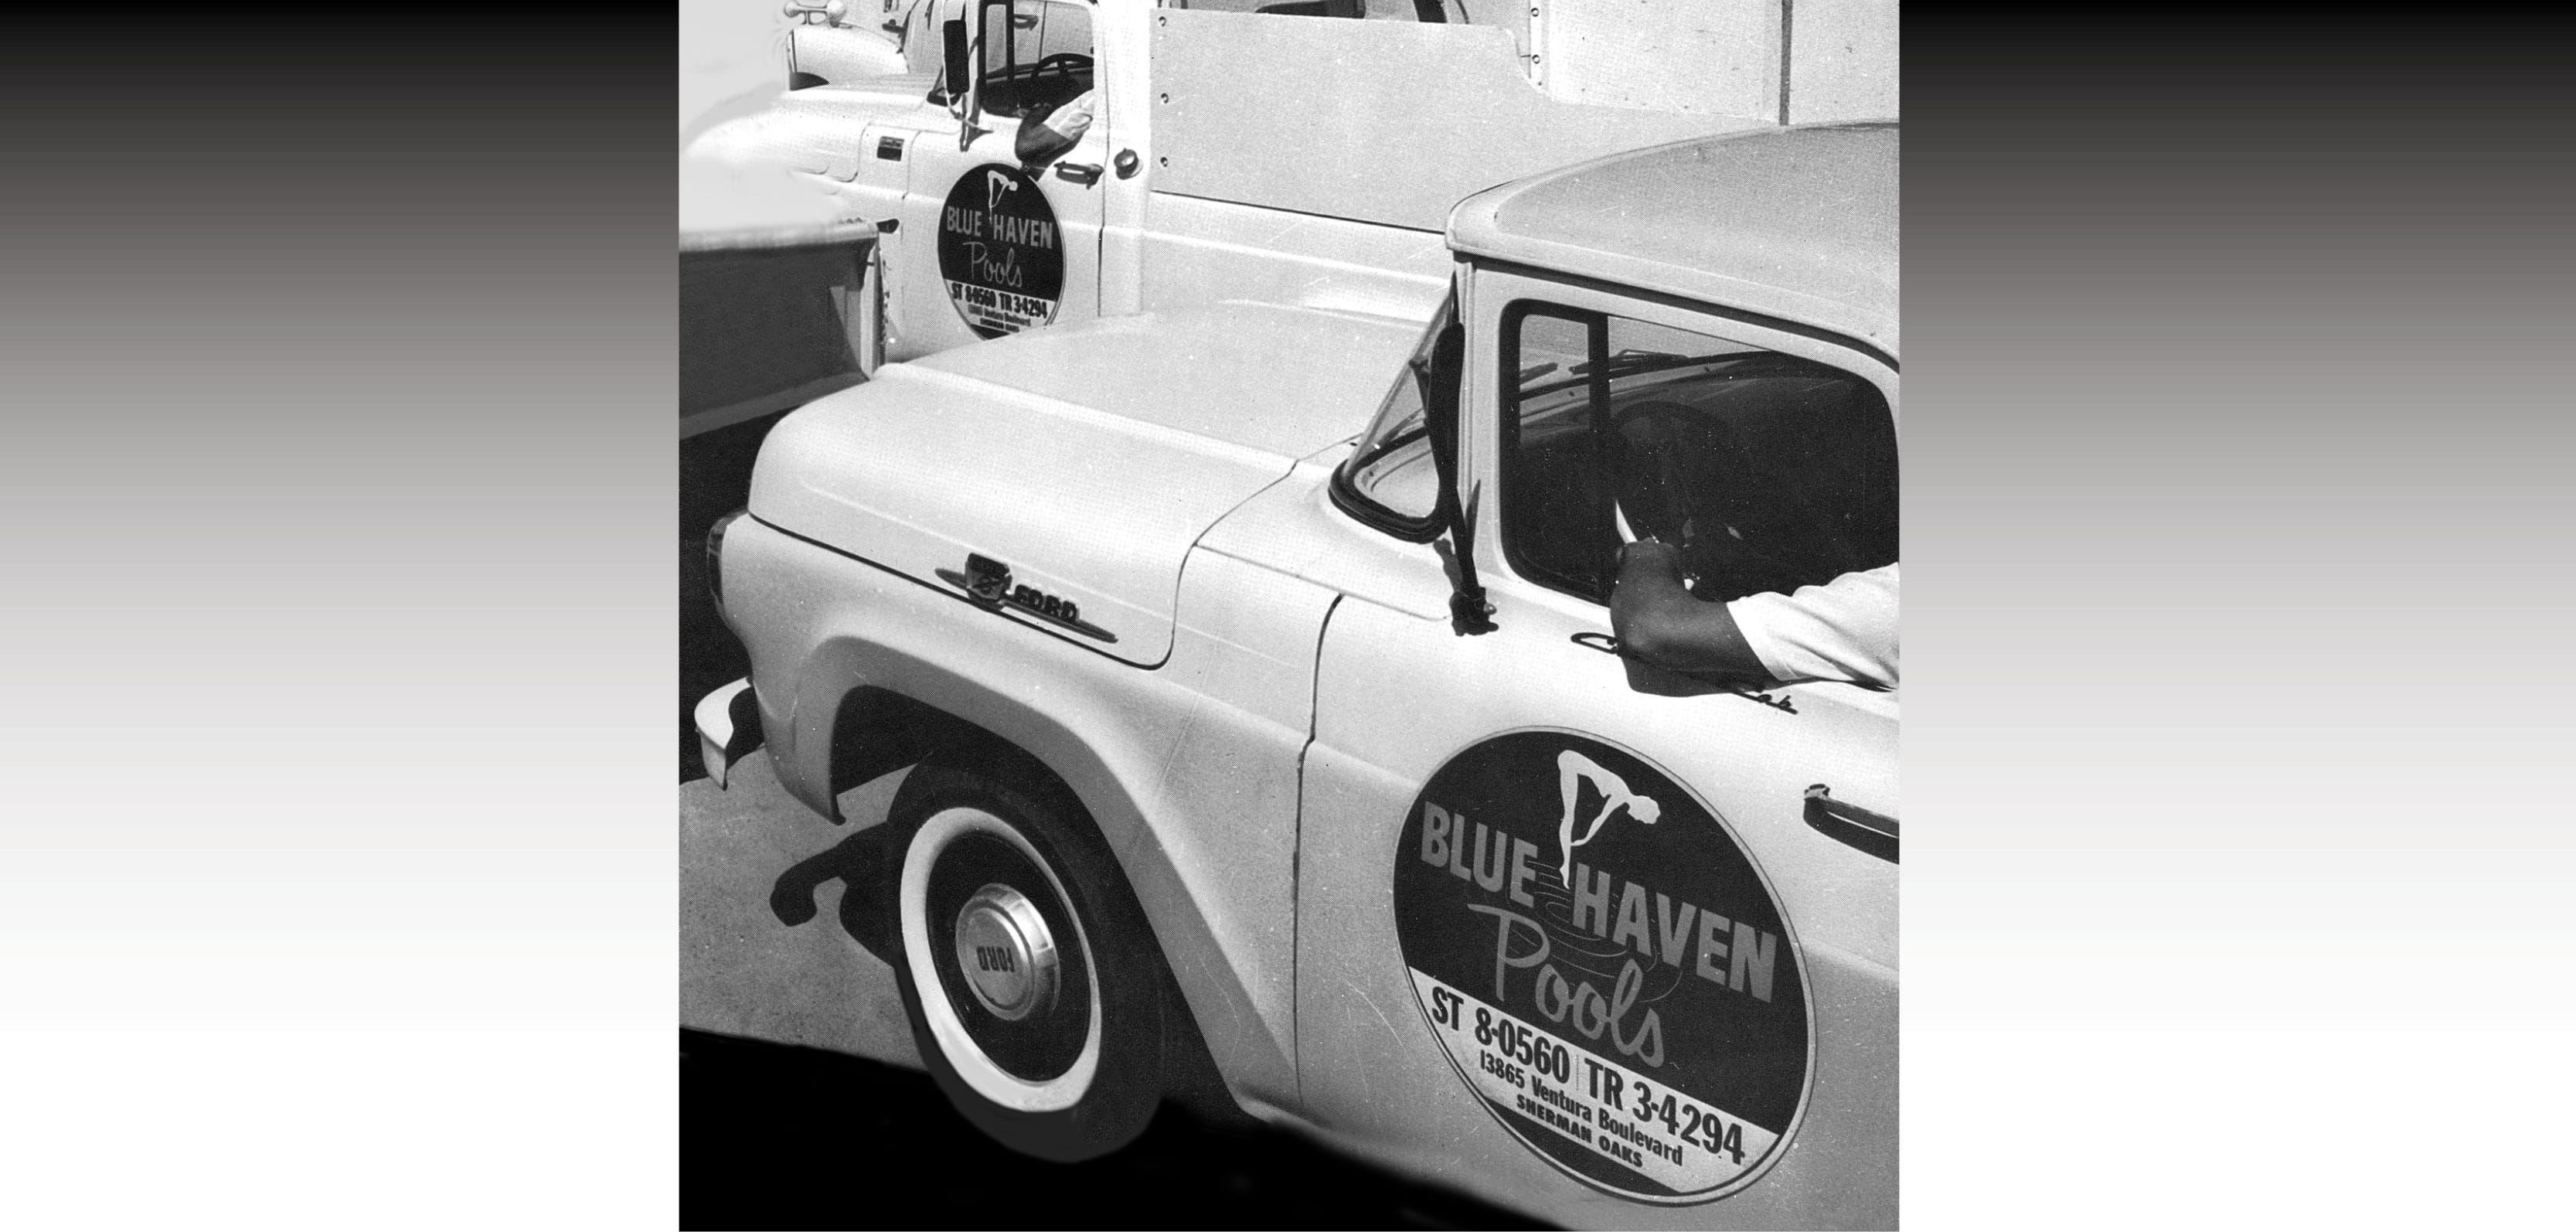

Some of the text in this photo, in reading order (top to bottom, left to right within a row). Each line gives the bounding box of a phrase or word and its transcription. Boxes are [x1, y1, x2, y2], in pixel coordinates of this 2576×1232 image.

[947, 206, 1053, 249] BLUE HAVEN
[963, 241, 1022, 288] Pools
[951, 282, 963, 300] ST
[999, 292, 1012, 311] TR
[1014, 584, 1080, 623] FORD
[1420, 801, 1777, 1003] BLUE HAVEN
[1468, 904, 1664, 1067] Pools
[1432, 986, 1745, 1166] ST 8-0560 TR 3-4294
[1480, 1050, 1684, 1166] 13865 Ventura Boulevard
[1516, 1094, 1643, 1168] SHERMAN OAKS
